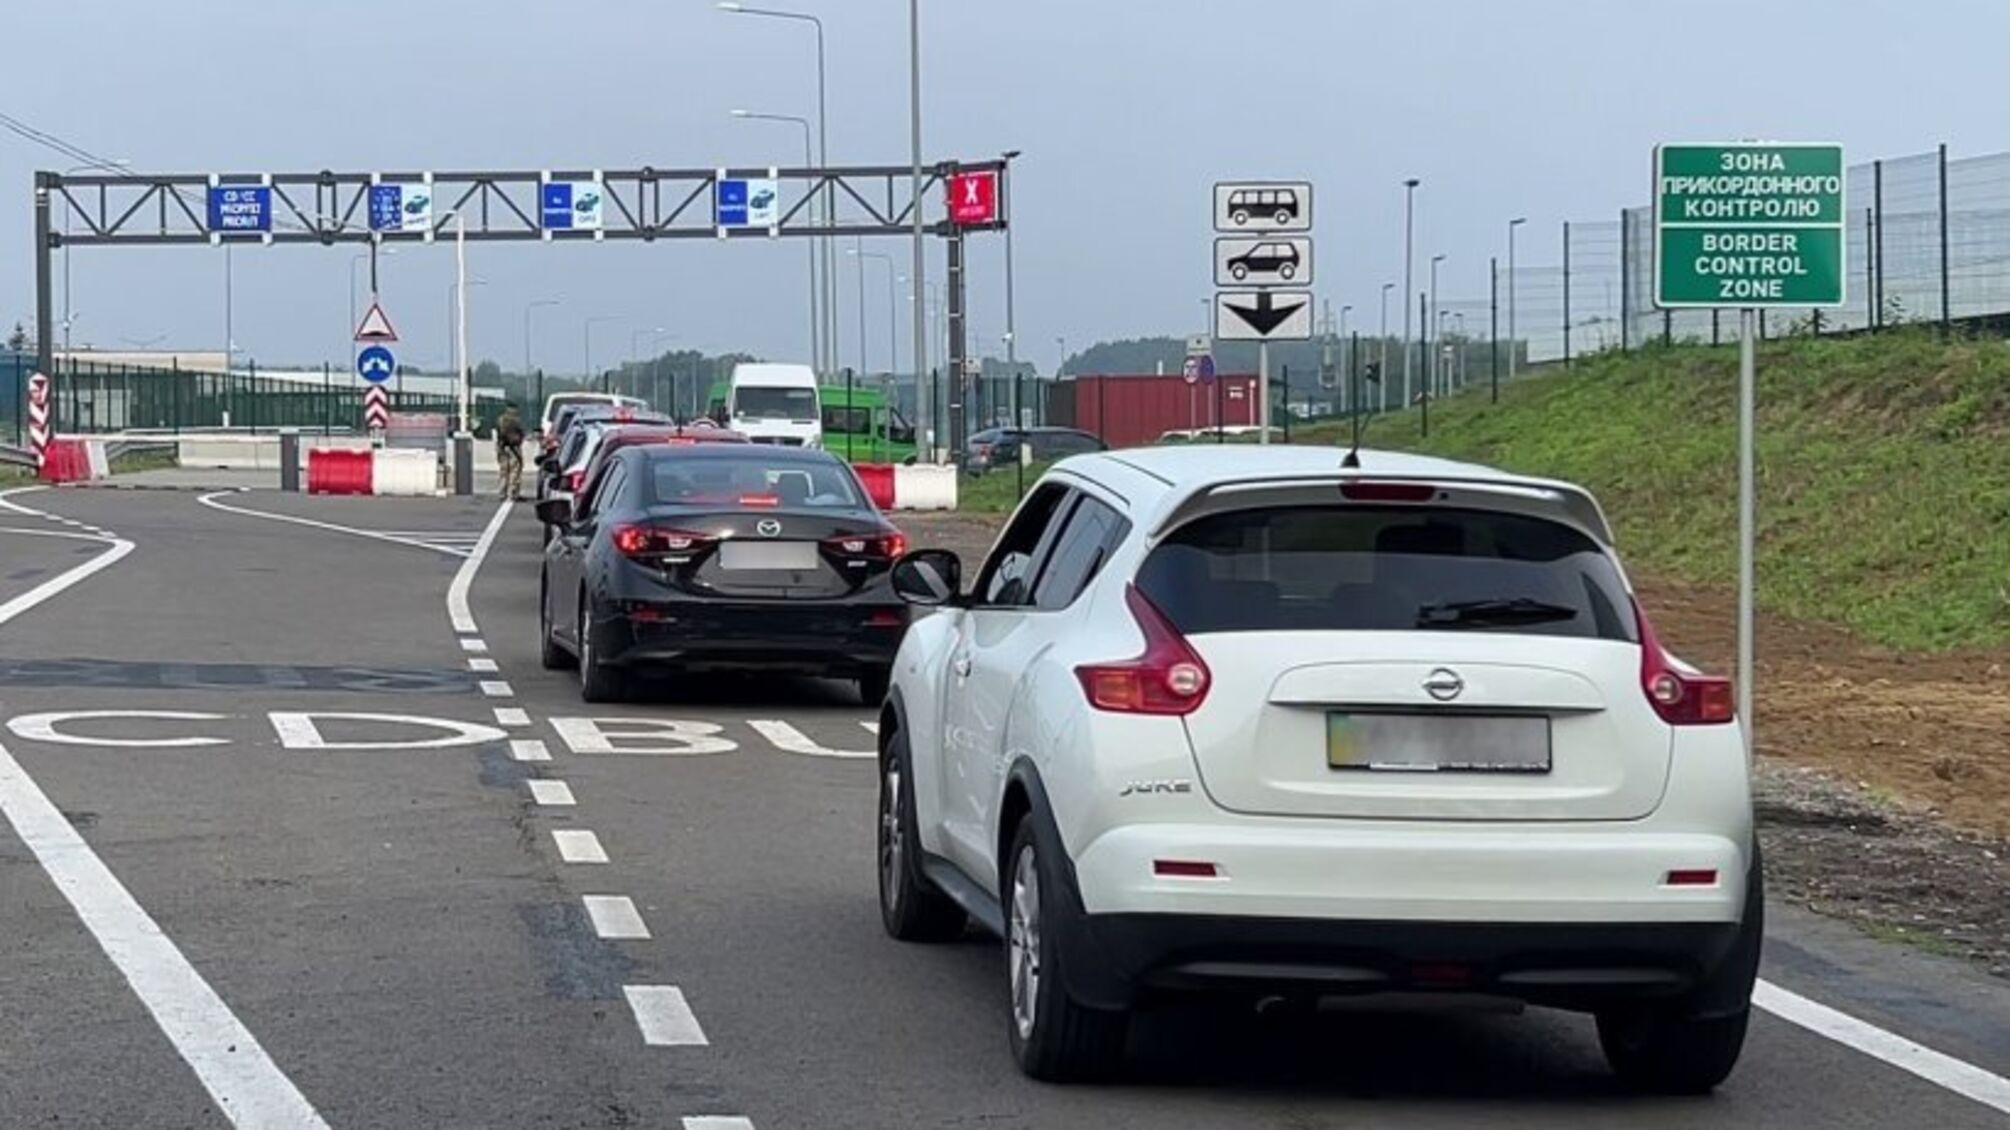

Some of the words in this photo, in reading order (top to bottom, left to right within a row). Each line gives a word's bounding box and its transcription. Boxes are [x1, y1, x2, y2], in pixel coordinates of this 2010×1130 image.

[1720, 153, 1786, 171] ЗОНА
[1662, 176, 1840, 196] ПРИКОРДОННОГО
[1685, 199, 1820, 217] КОНТРОЛЮ
[1702, 234, 1798, 251] BORDER
[1695, 256, 1807, 274] CONTROL
[1720, 279, 1784, 297] ZONE
[1120, 780, 1192, 797] JUKE
